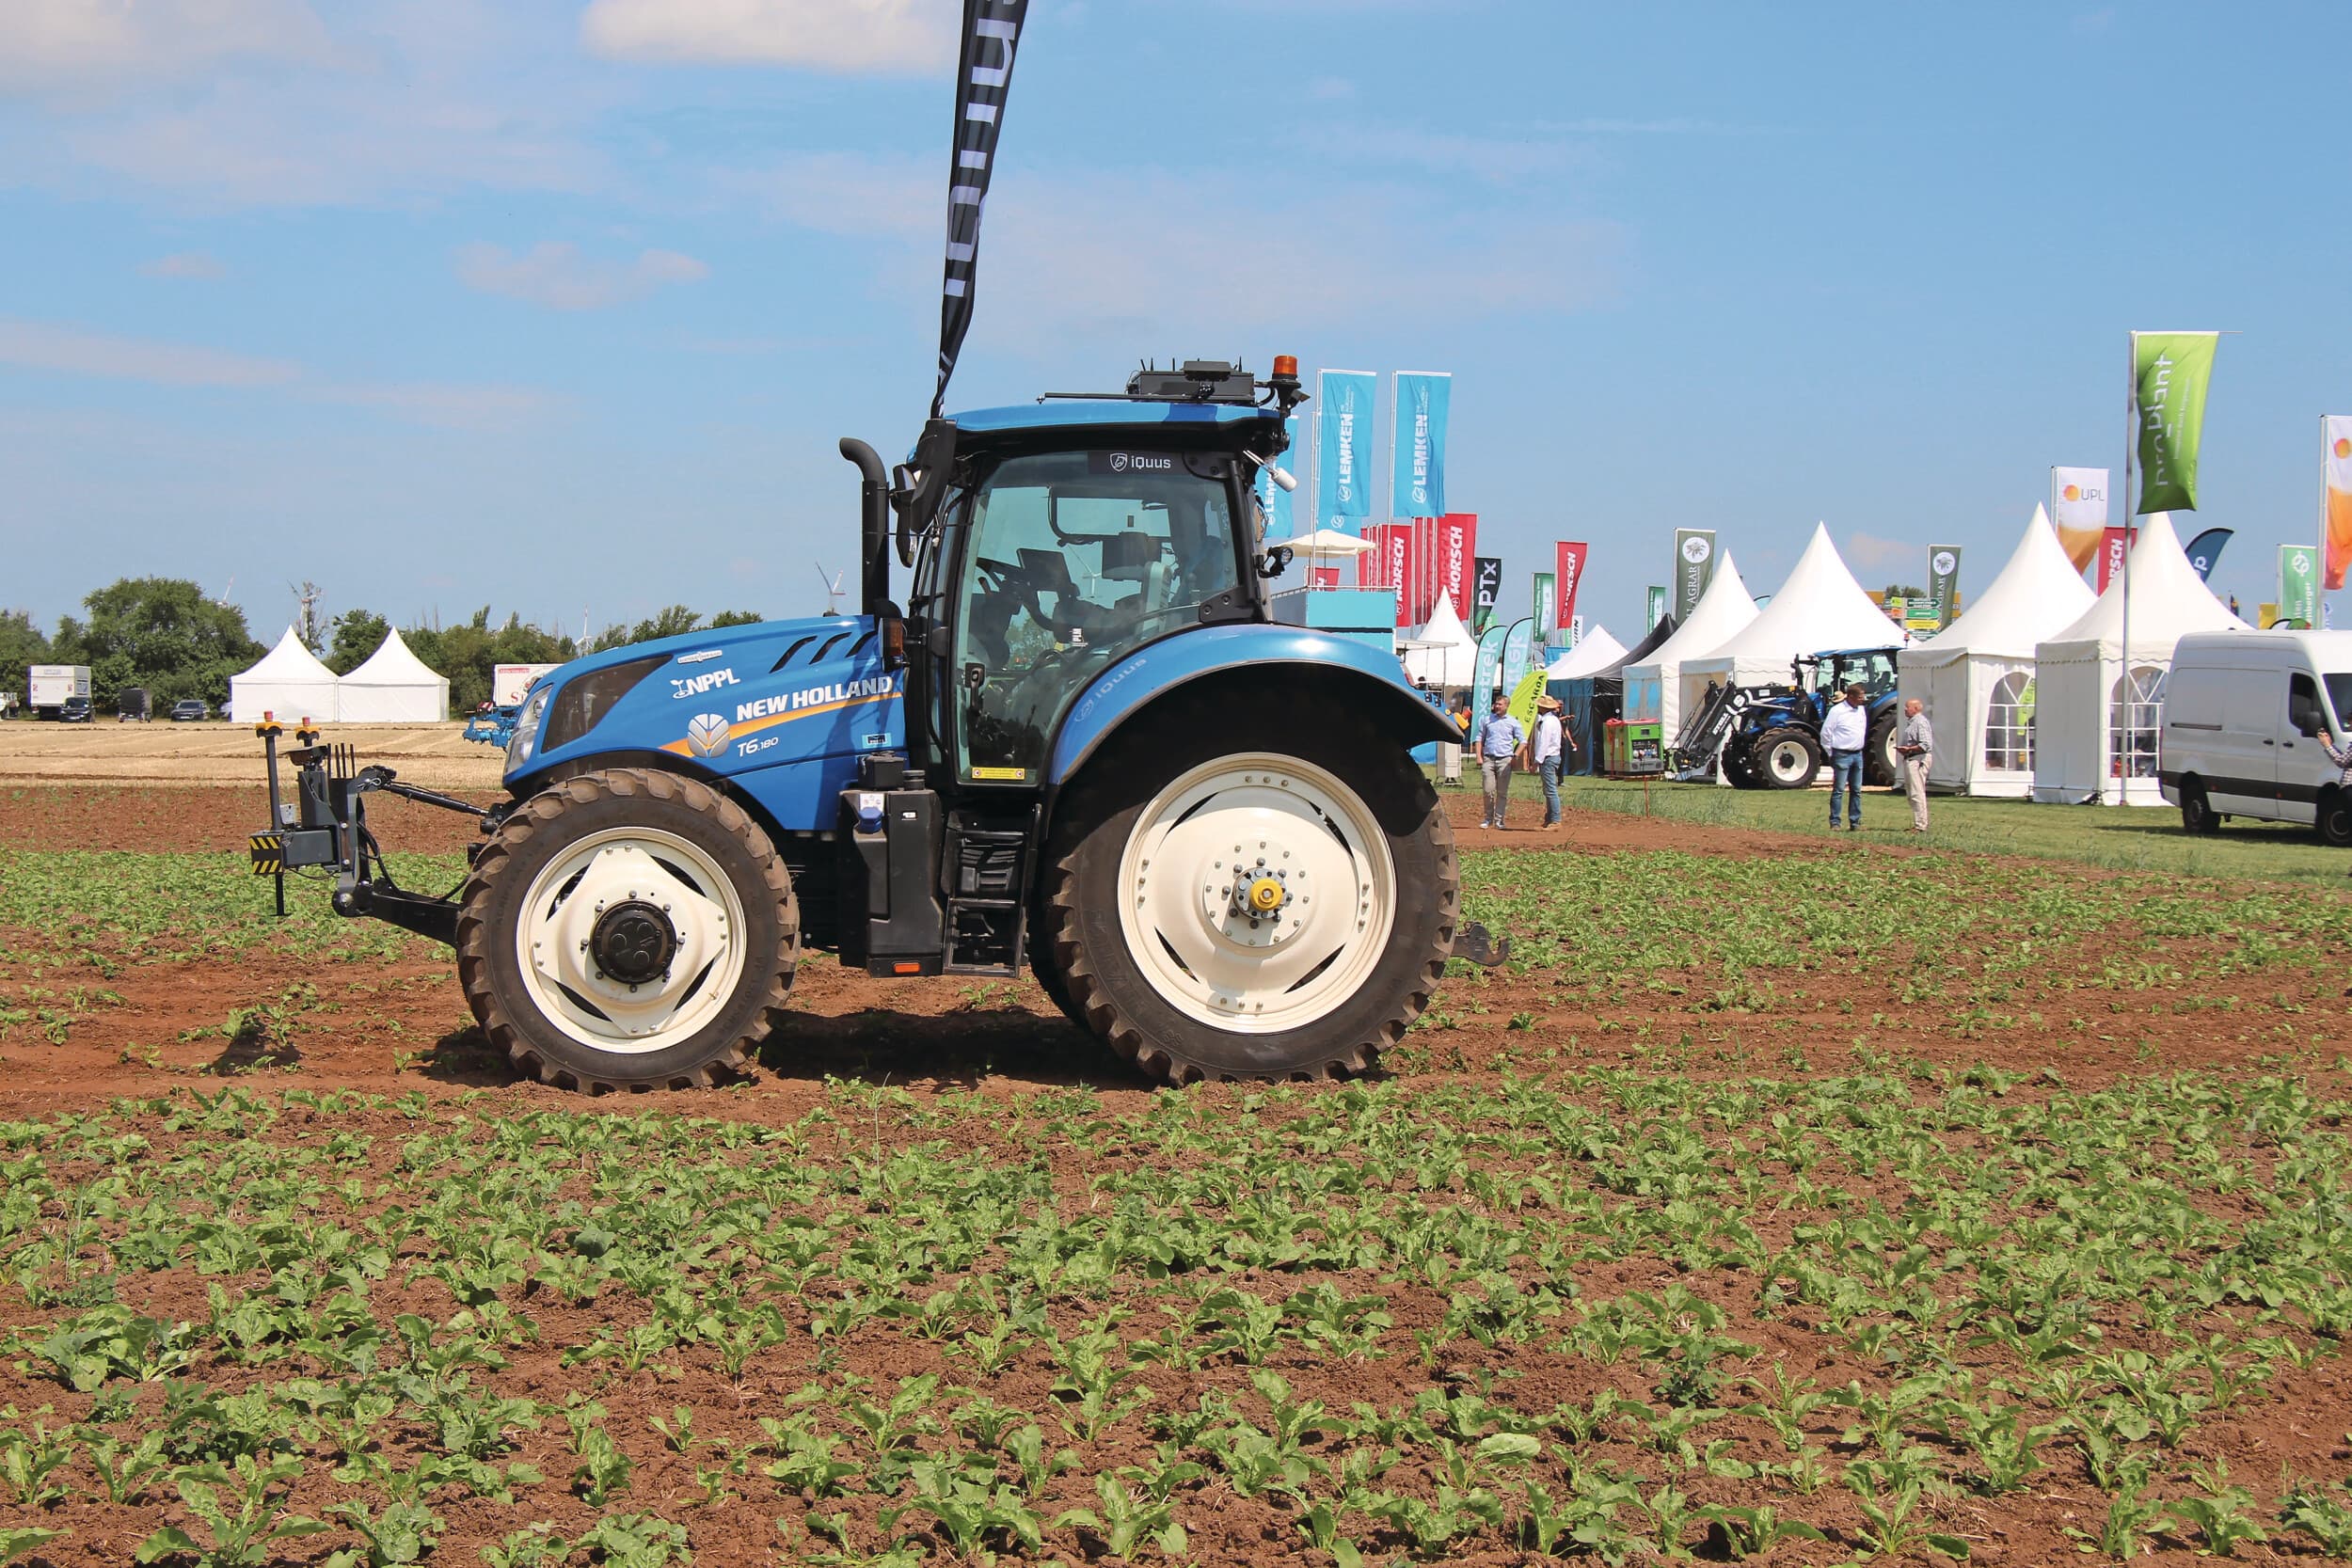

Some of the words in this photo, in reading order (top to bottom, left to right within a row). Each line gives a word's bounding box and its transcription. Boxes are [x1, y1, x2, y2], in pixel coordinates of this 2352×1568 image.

[1131, 455, 1171, 469] iQuus
[1339, 414, 1354, 484] LEMKEN
[1414, 414, 1429, 485] LEMKEN
[2081, 488, 2106, 501] UPL
[1450, 526, 1463, 594] HORSCH
[1478, 561, 1496, 607] PTx
[1686, 565, 1697, 604] AGRAR
[737, 693, 788, 722] NEW
[792, 675, 893, 709] HOLLAND
